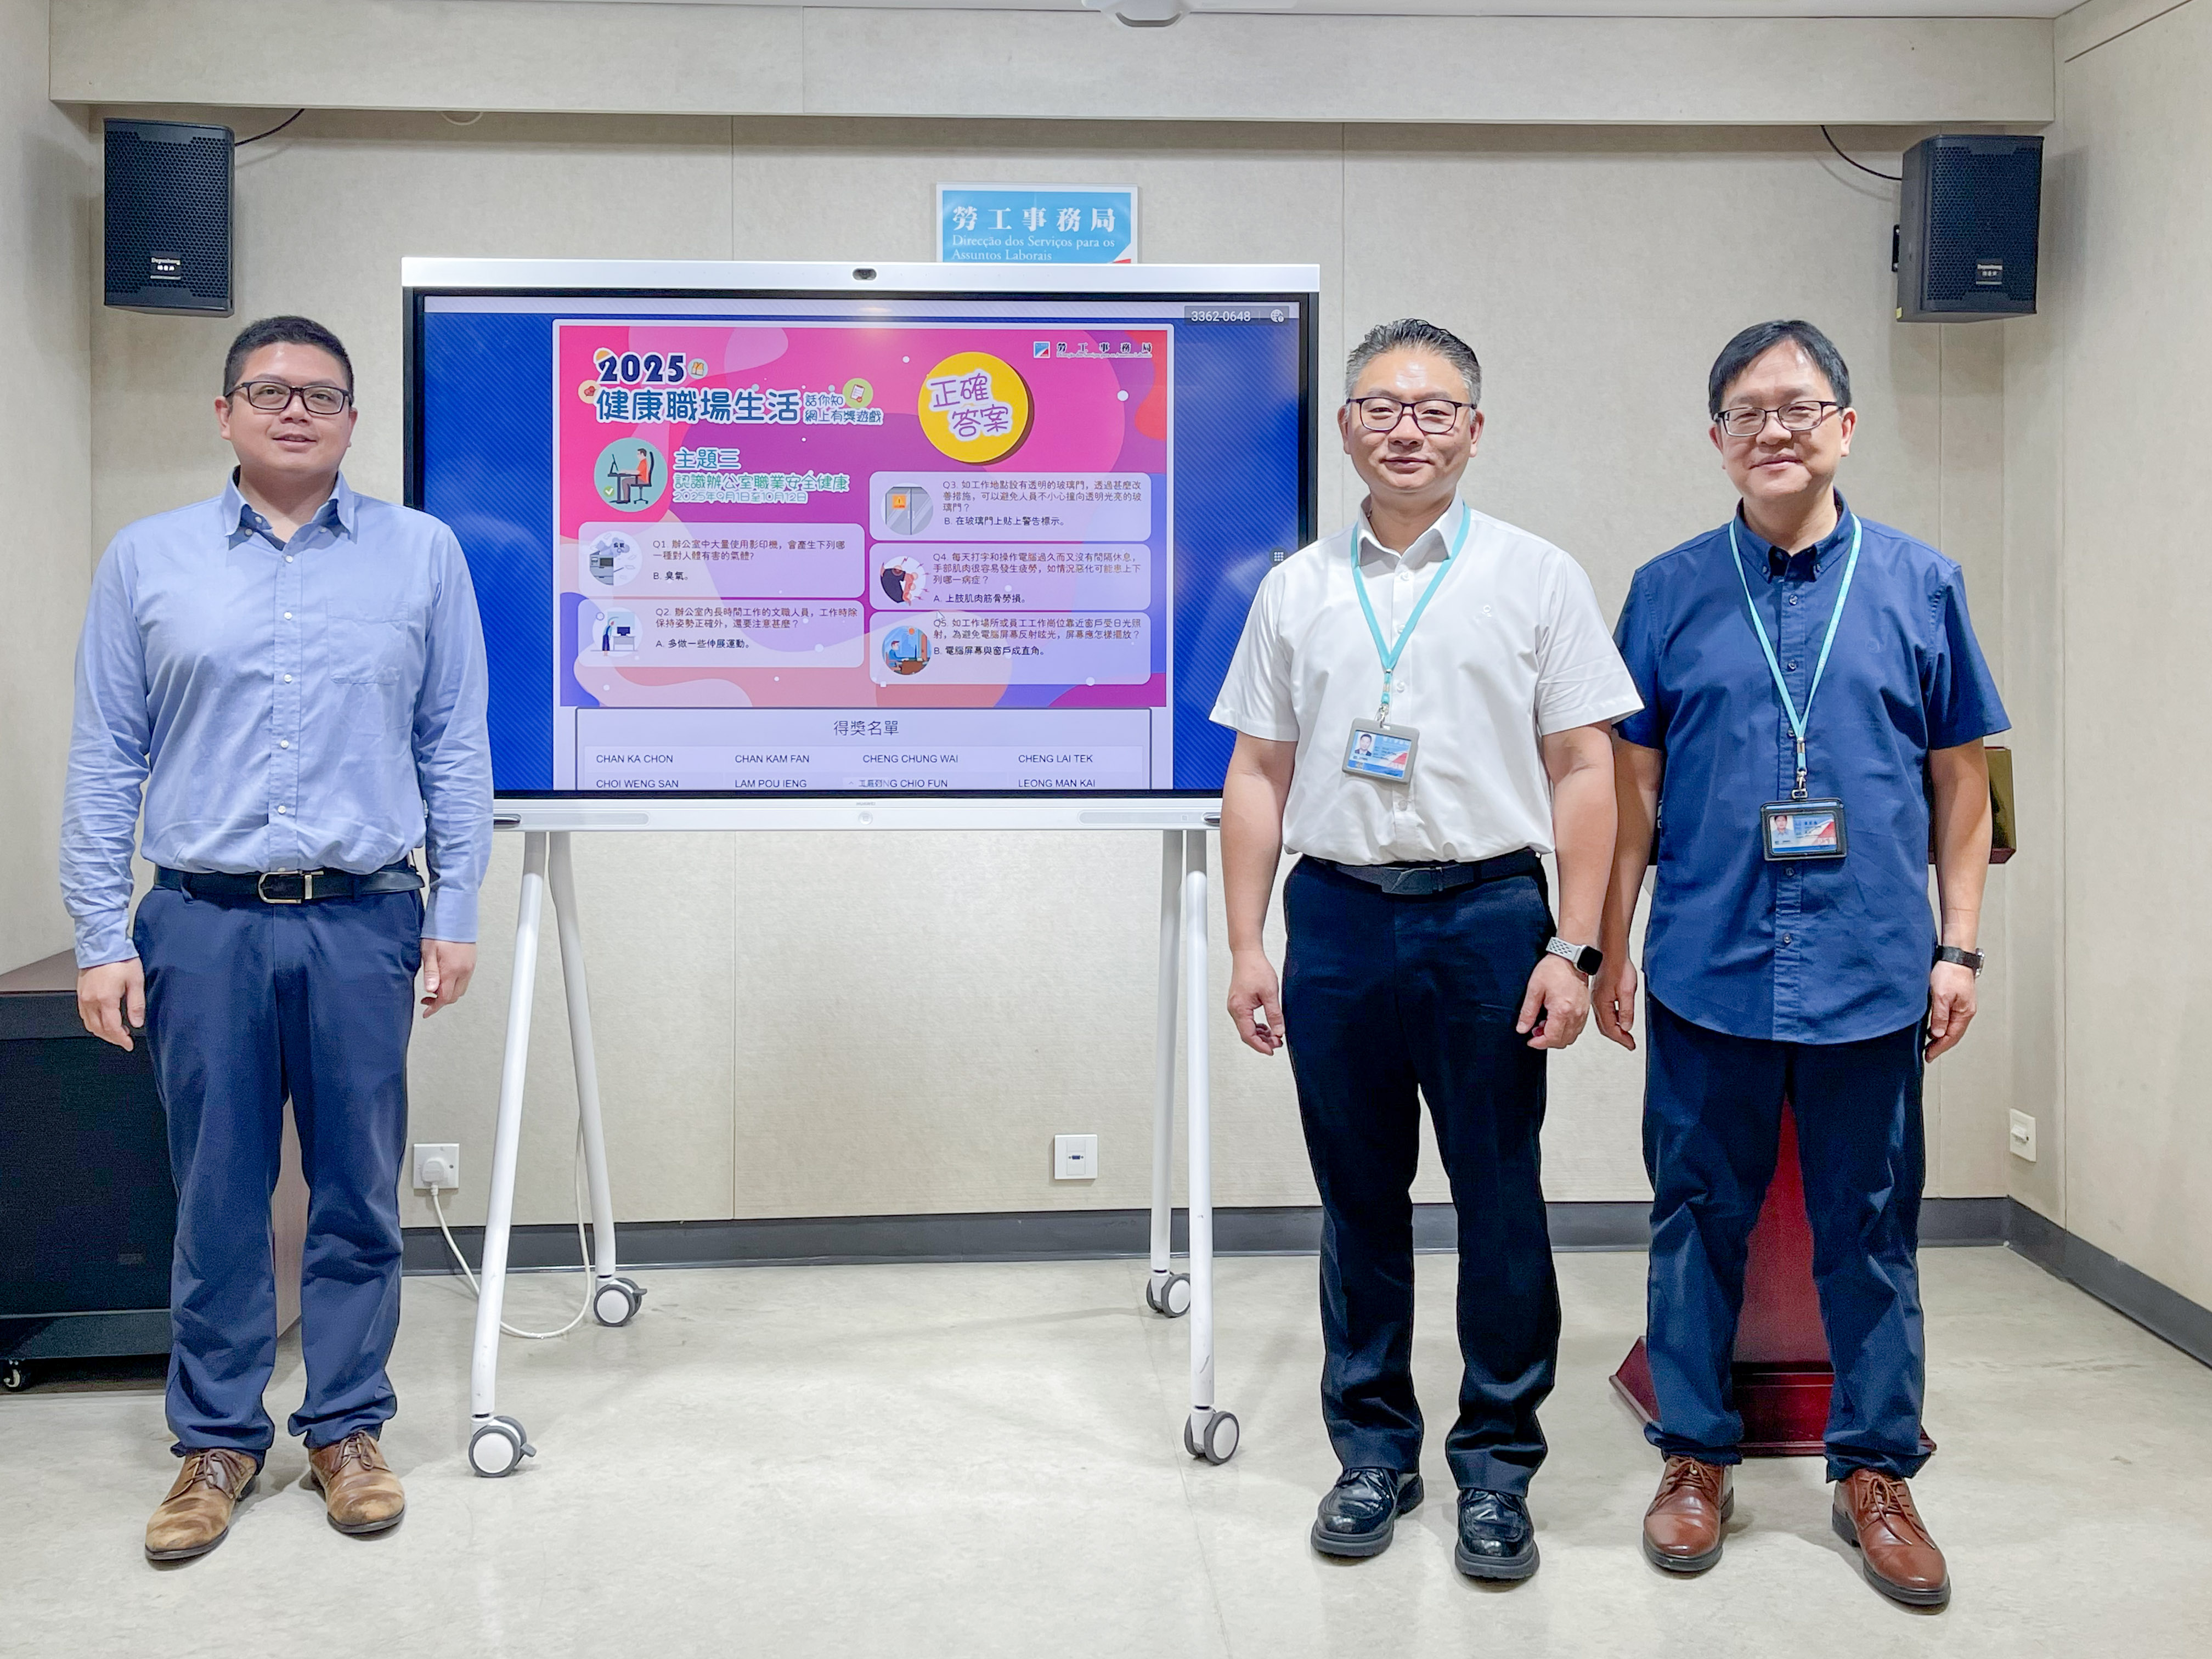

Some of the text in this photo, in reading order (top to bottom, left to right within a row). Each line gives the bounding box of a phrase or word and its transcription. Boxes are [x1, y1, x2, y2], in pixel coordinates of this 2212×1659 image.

[952, 206, 1115, 232] 勞工事務局
[952, 235, 1001, 248] Direcção
[1005, 236, 1024, 246] dos
[1028, 236, 1073, 249] Serviços
[1077, 240, 1099, 250] para
[952, 250, 1052, 261] Assuntos Laborais
[1191, 311, 1251, 322] 3362-0648
[599, 354, 684, 382] 2025
[930, 373, 989, 408] 正確
[596, 391, 799, 421] 健康職場生活
[805, 394, 844, 407] 話你知
[952, 404, 1008, 437] 答案
[675, 449, 739, 469] 主題三
[675, 474, 849, 490] 認識辦公室職業安全健康
[834, 720, 899, 736] 得獎名單
[596, 755, 673, 764] CHAN KA CHON
[735, 755, 809, 764] CHAN KAM FAN
[863, 755, 958, 764] CHENG CHUNG WAI
[1018, 755, 1093, 764] CHENG LAI TEK
[596, 779, 679, 788] CHOI WENG SAN
[735, 779, 807, 788] LAM POU IENG
[900, 780, 925, 788] CHIO
[928, 780, 947, 788] FUN
[1018, 779, 1095, 788] LEONG MAN KAI
